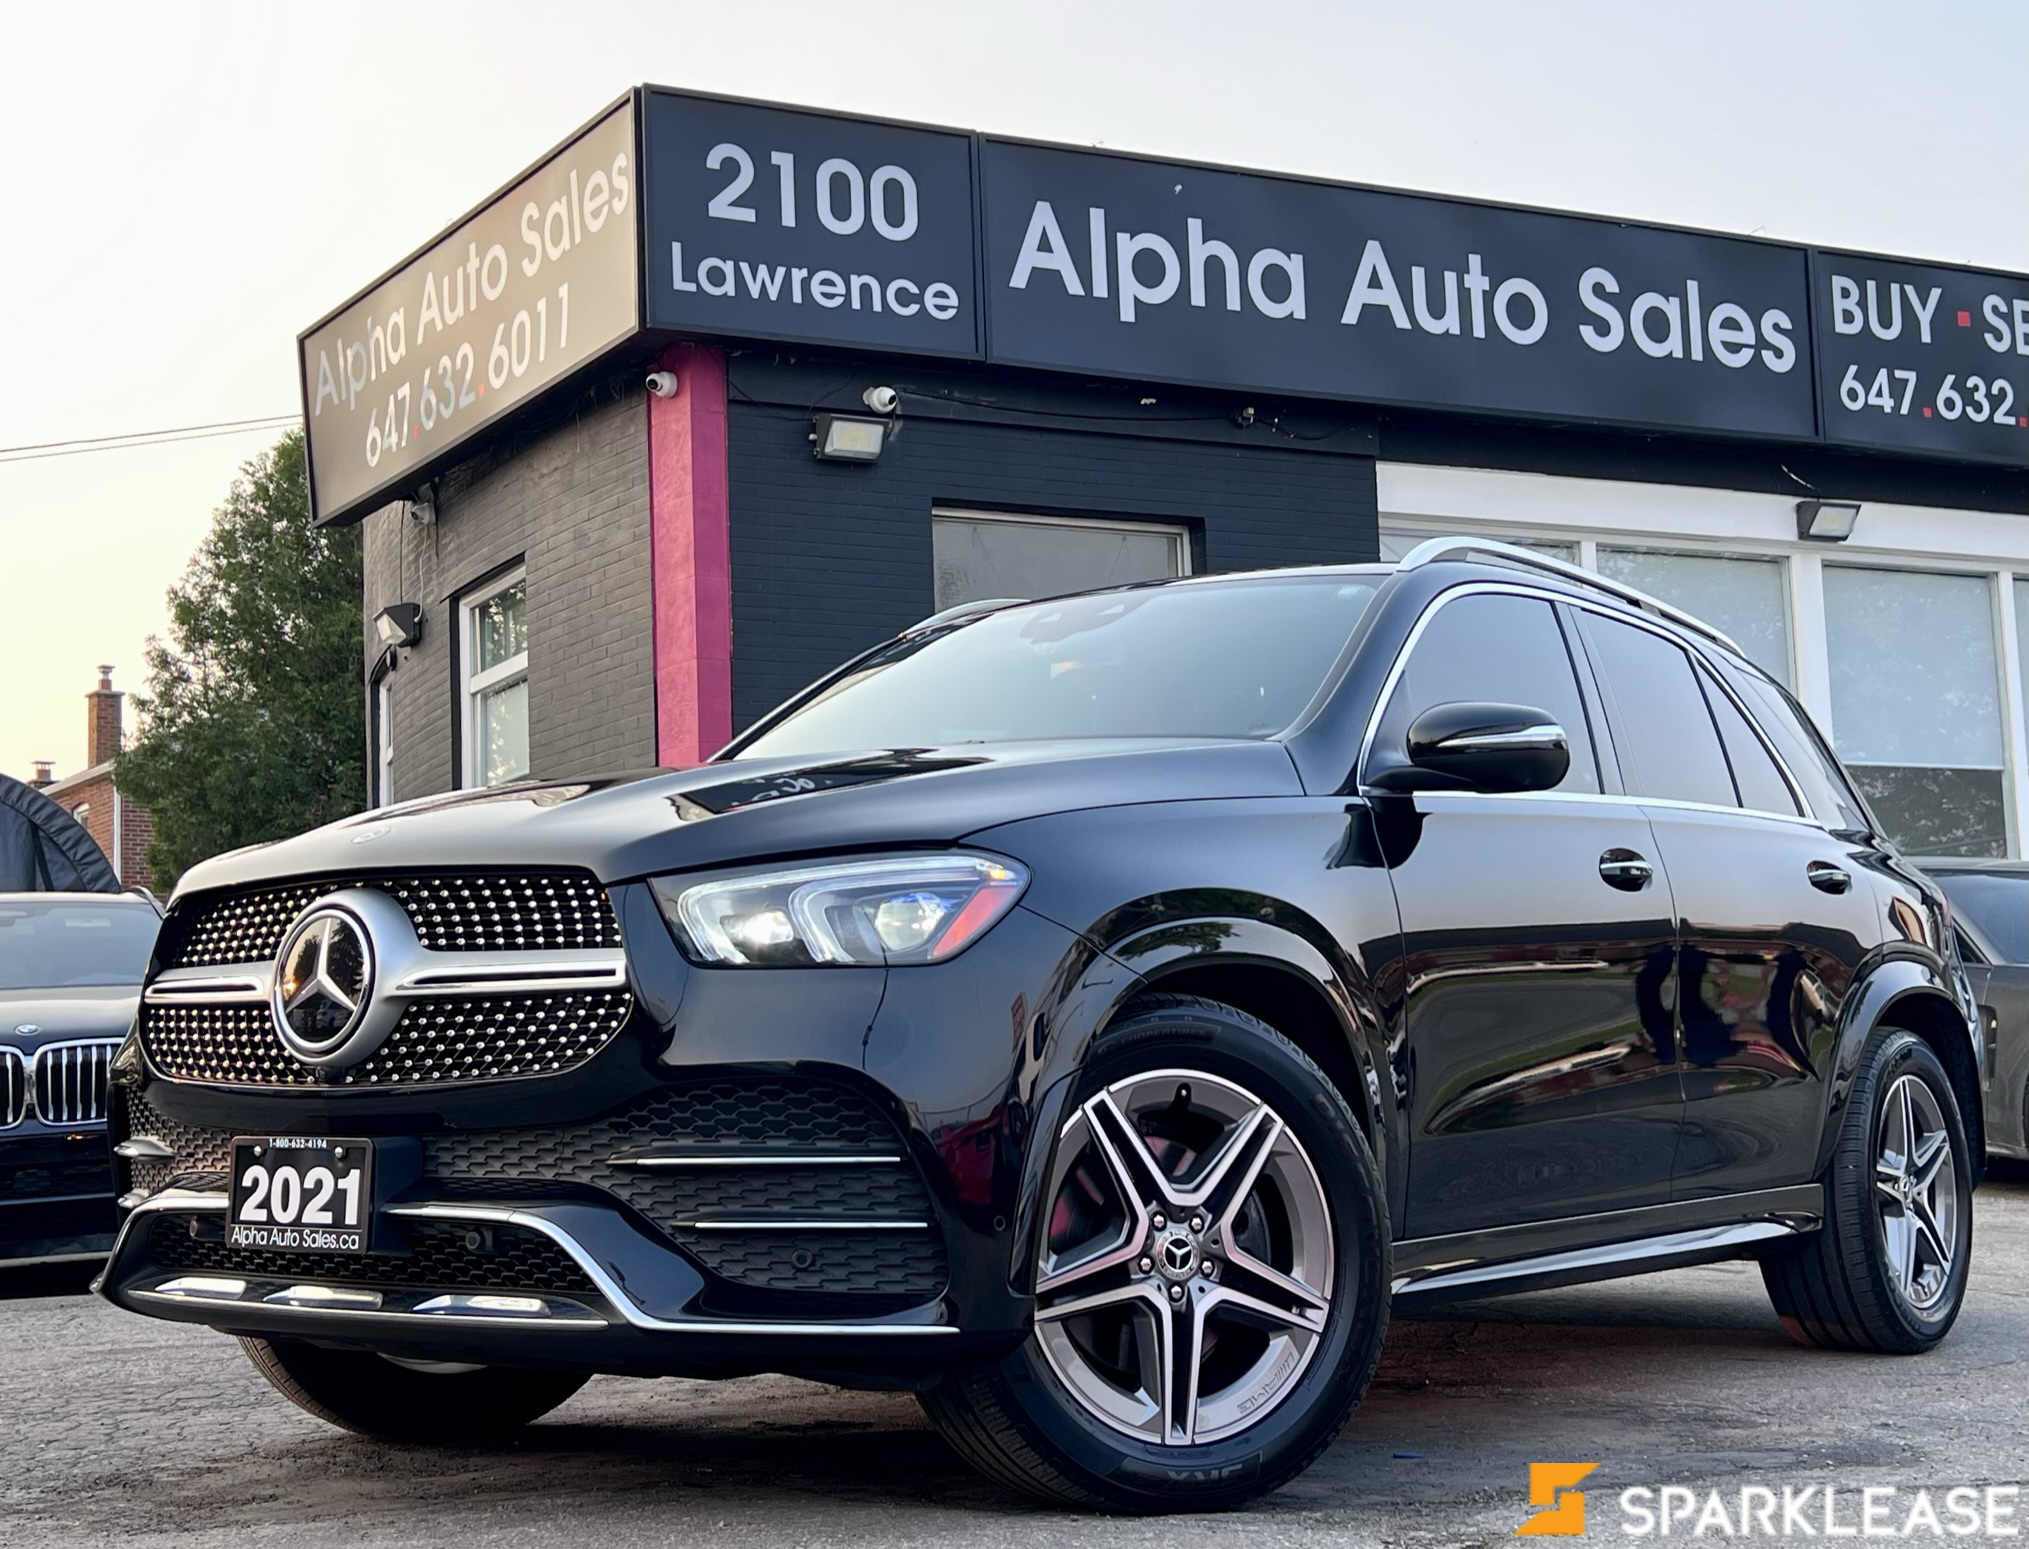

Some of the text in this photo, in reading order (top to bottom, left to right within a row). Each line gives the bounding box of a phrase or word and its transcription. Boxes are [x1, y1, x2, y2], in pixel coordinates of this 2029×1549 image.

[706, 142, 920, 242] 2100
[315, 152, 629, 416] Alpha Auto Sales
[671, 240, 960, 321] Lawrence
[1008, 200, 1797, 374] Alpha Auto Sales
[1831, 274, 2029, 356] BUY SE
[269, 1137, 327, 1149] 1-800-632-4194
[239, 1164, 361, 1226] 2021
[230, 1226, 359, 1249] Alpha Auto Sales.ca
